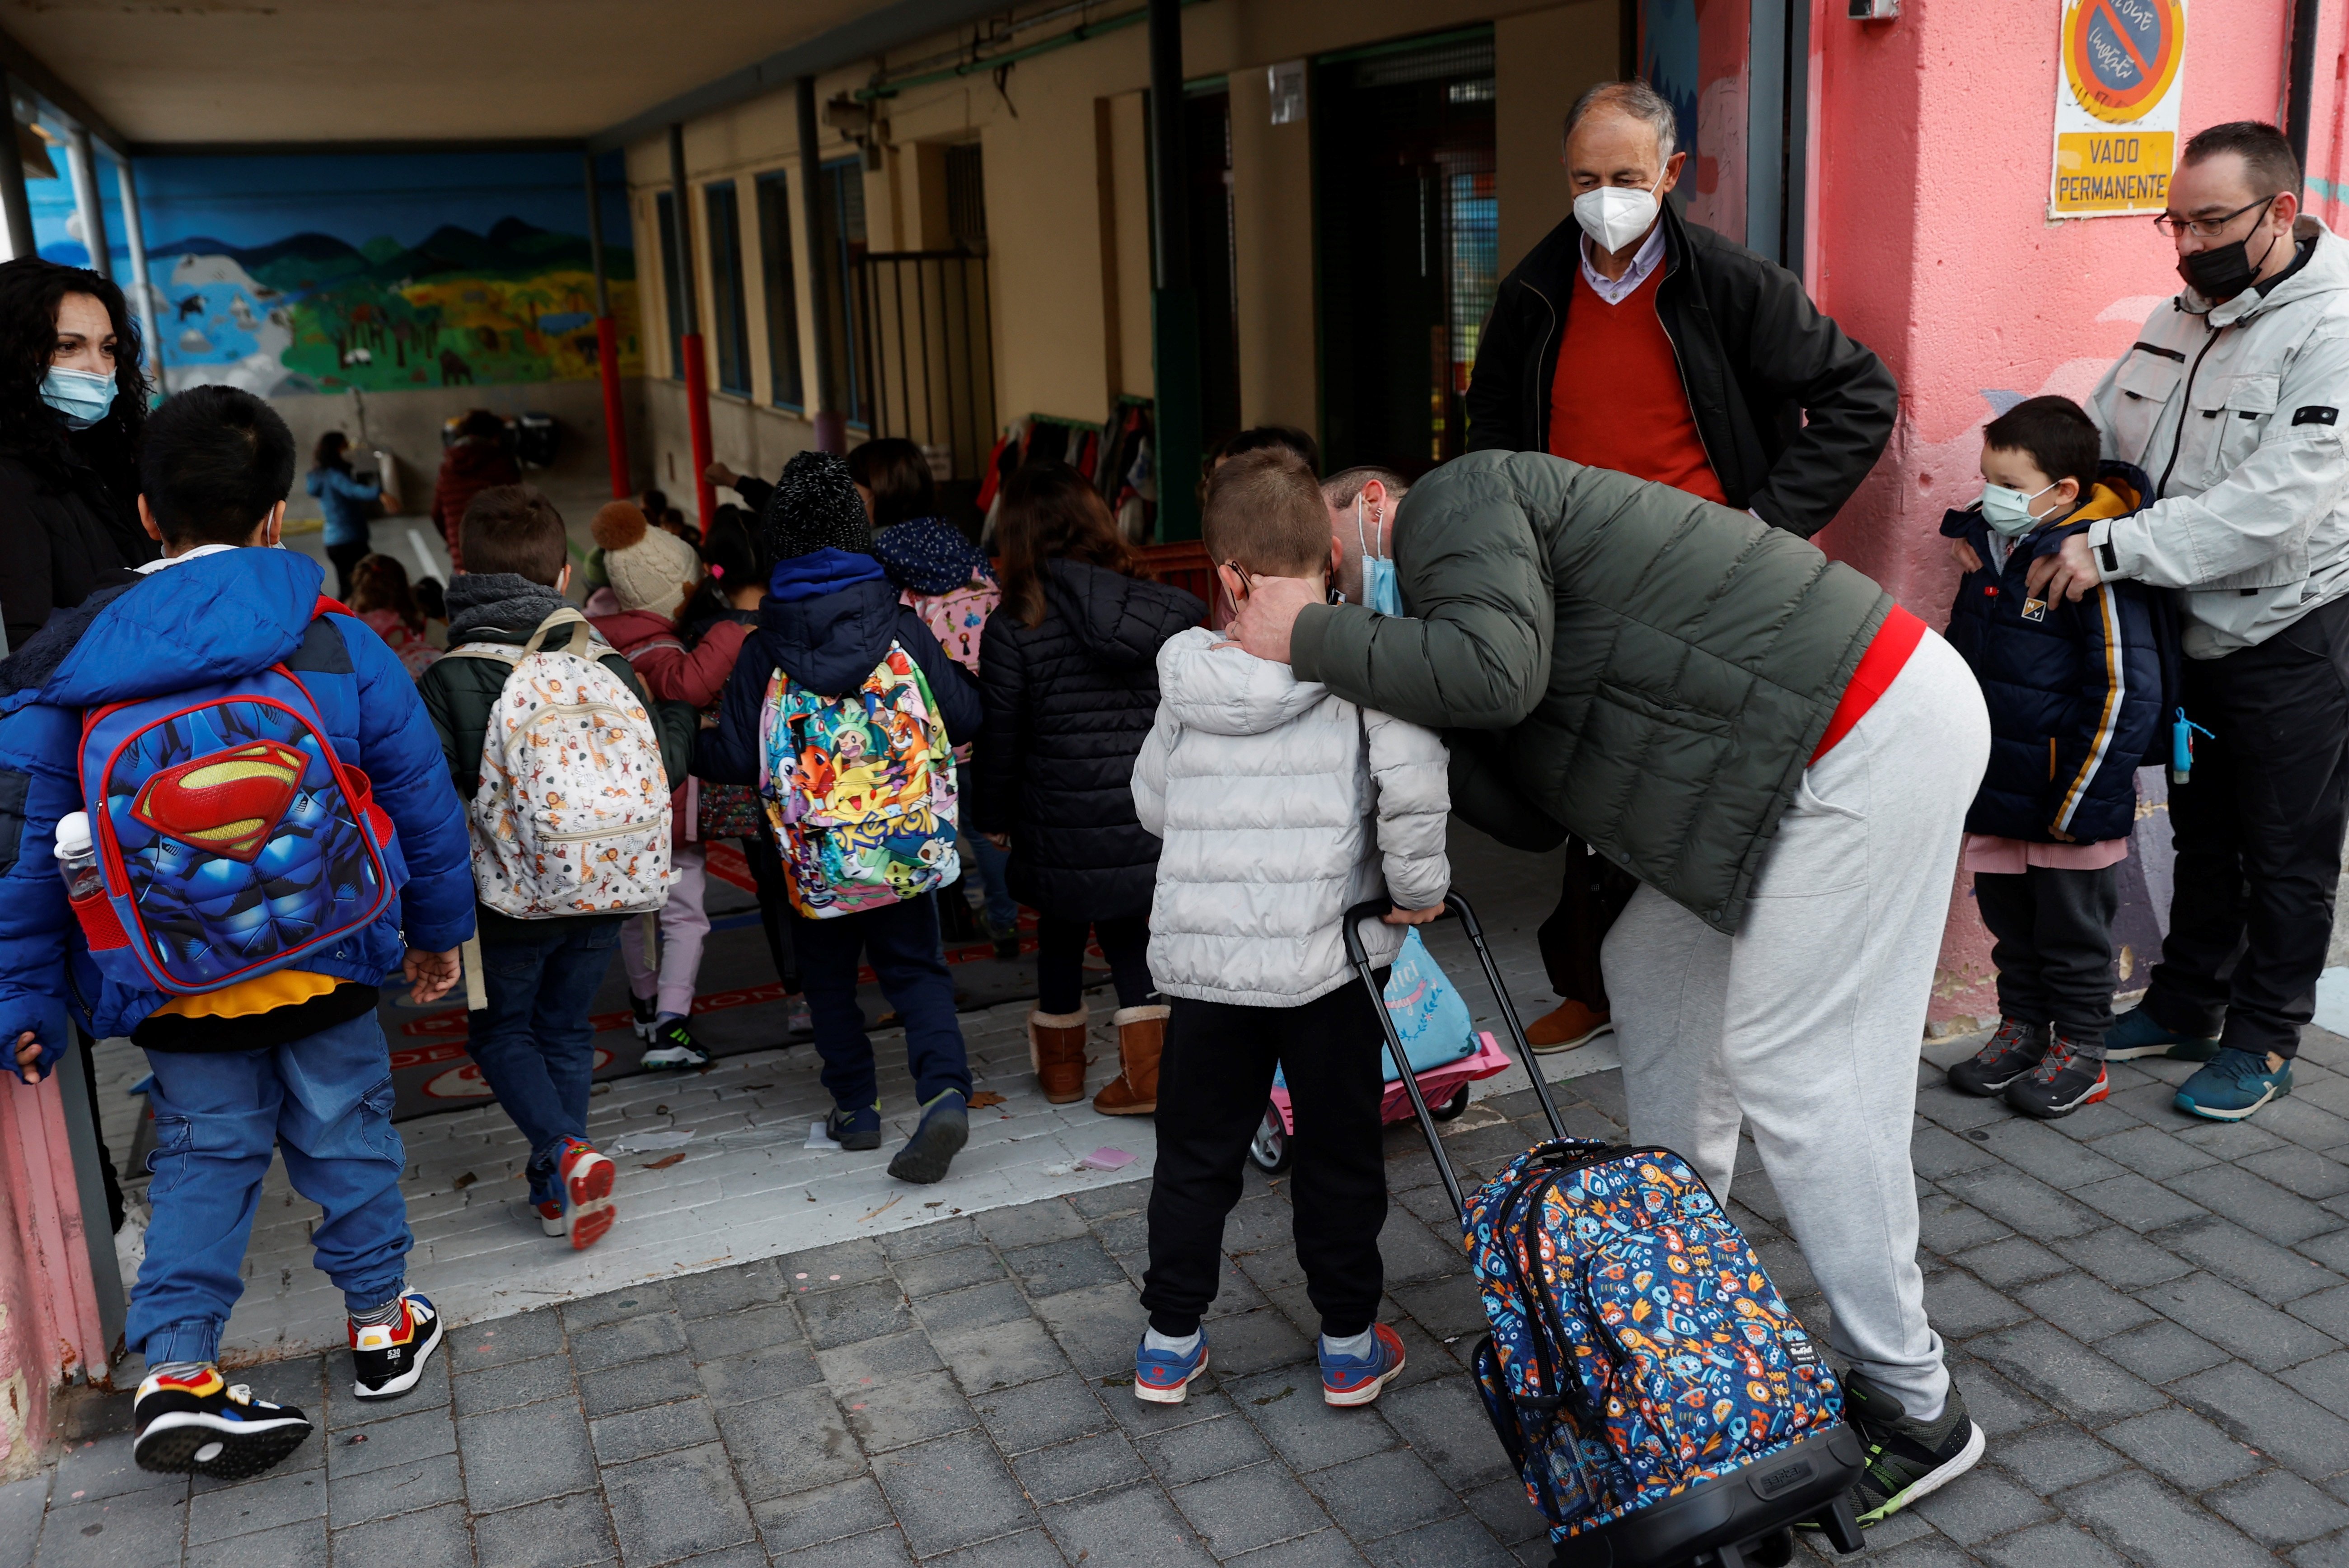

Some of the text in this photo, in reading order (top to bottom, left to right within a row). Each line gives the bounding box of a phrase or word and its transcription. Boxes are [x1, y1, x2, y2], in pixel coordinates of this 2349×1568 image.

[2090, 138, 2138, 163] VADO
[2059, 174, 2167, 201] PERMANENTE
[2016, 494, 2022, 503] A
[387, 1348, 401, 1356] 530
